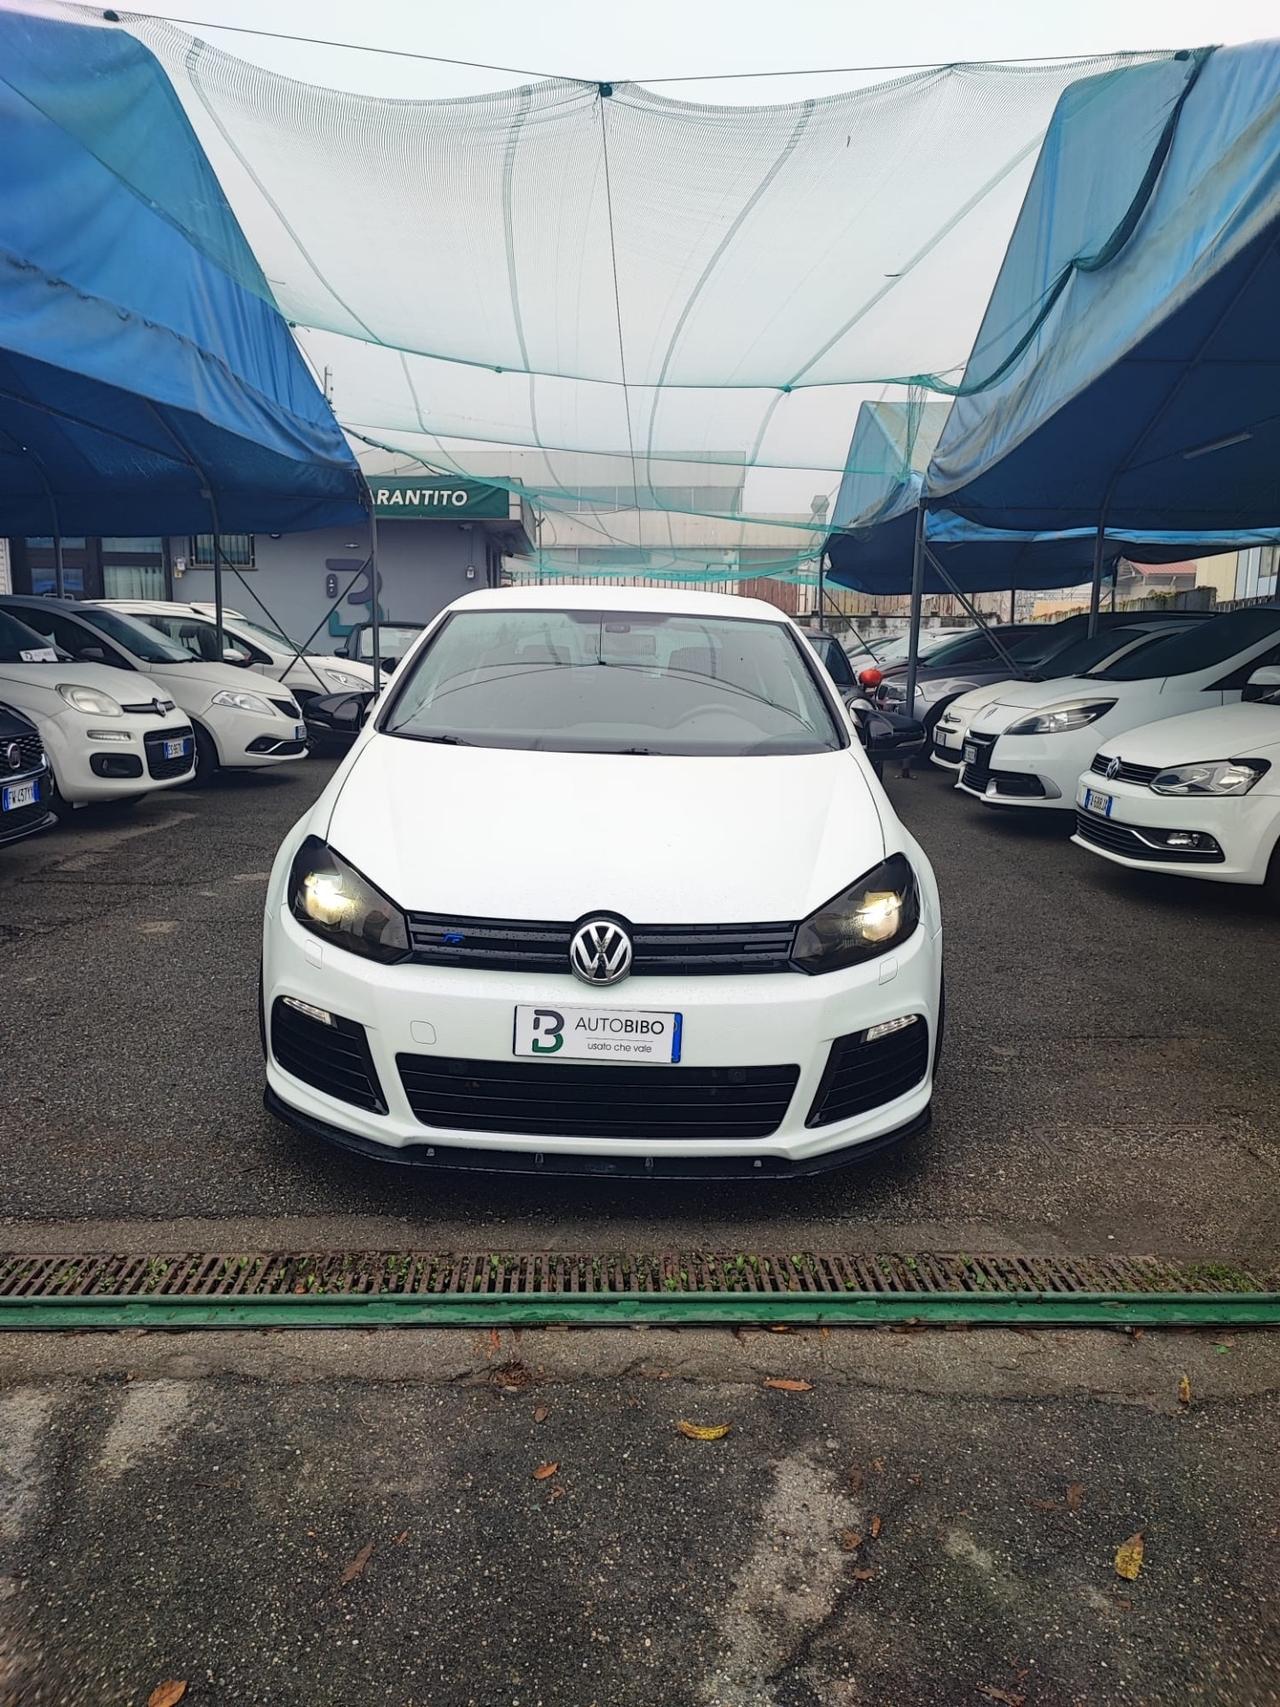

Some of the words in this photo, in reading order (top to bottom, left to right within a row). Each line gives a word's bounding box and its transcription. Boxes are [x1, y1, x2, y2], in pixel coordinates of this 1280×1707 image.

[574, 1016, 665, 1035] AUTOBIBO
[587, 1042, 612, 1051] usato
[614, 1043, 632, 1052] che
[633, 1044, 652, 1054] vale
